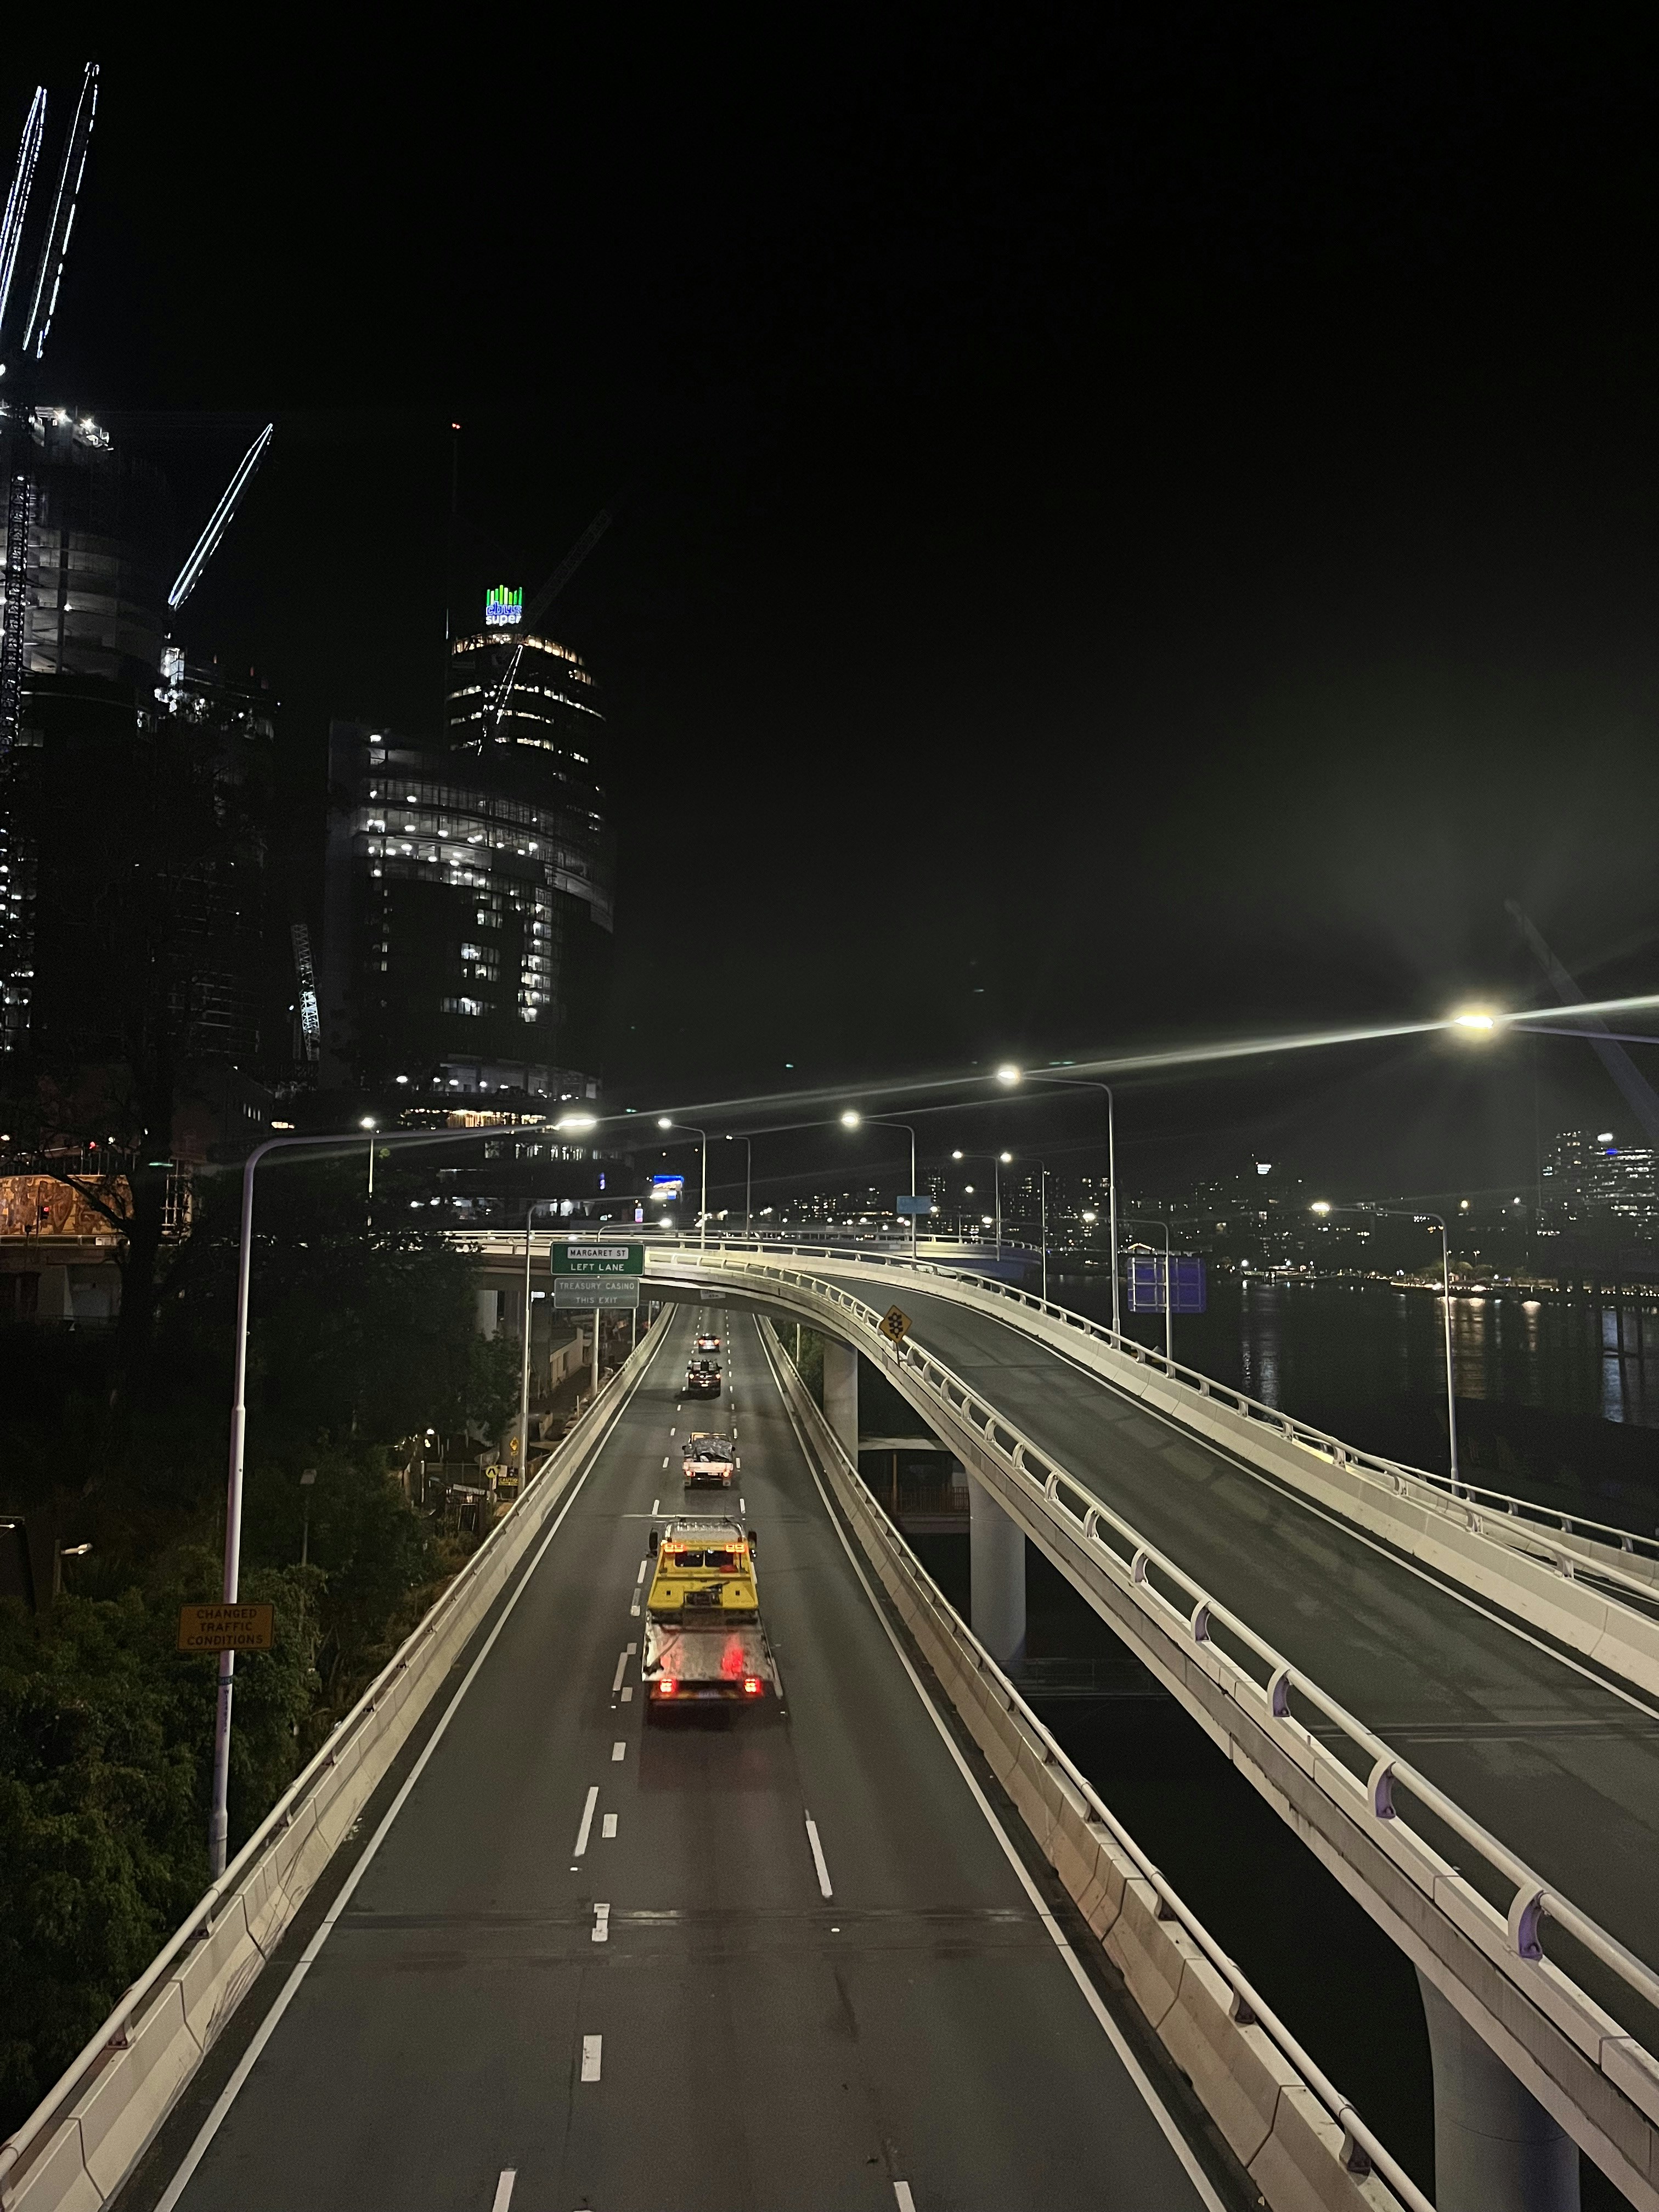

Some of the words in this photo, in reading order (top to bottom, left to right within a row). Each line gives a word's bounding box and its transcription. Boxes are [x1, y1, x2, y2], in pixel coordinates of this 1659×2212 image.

[486, 601, 522, 615] cbus
[486, 614, 522, 626] super
[196, 1609, 257, 1619] CHANGED
[200, 1622, 253, 1632] TRAFFIC
[187, 1634, 263, 1645] CONDITIONS
